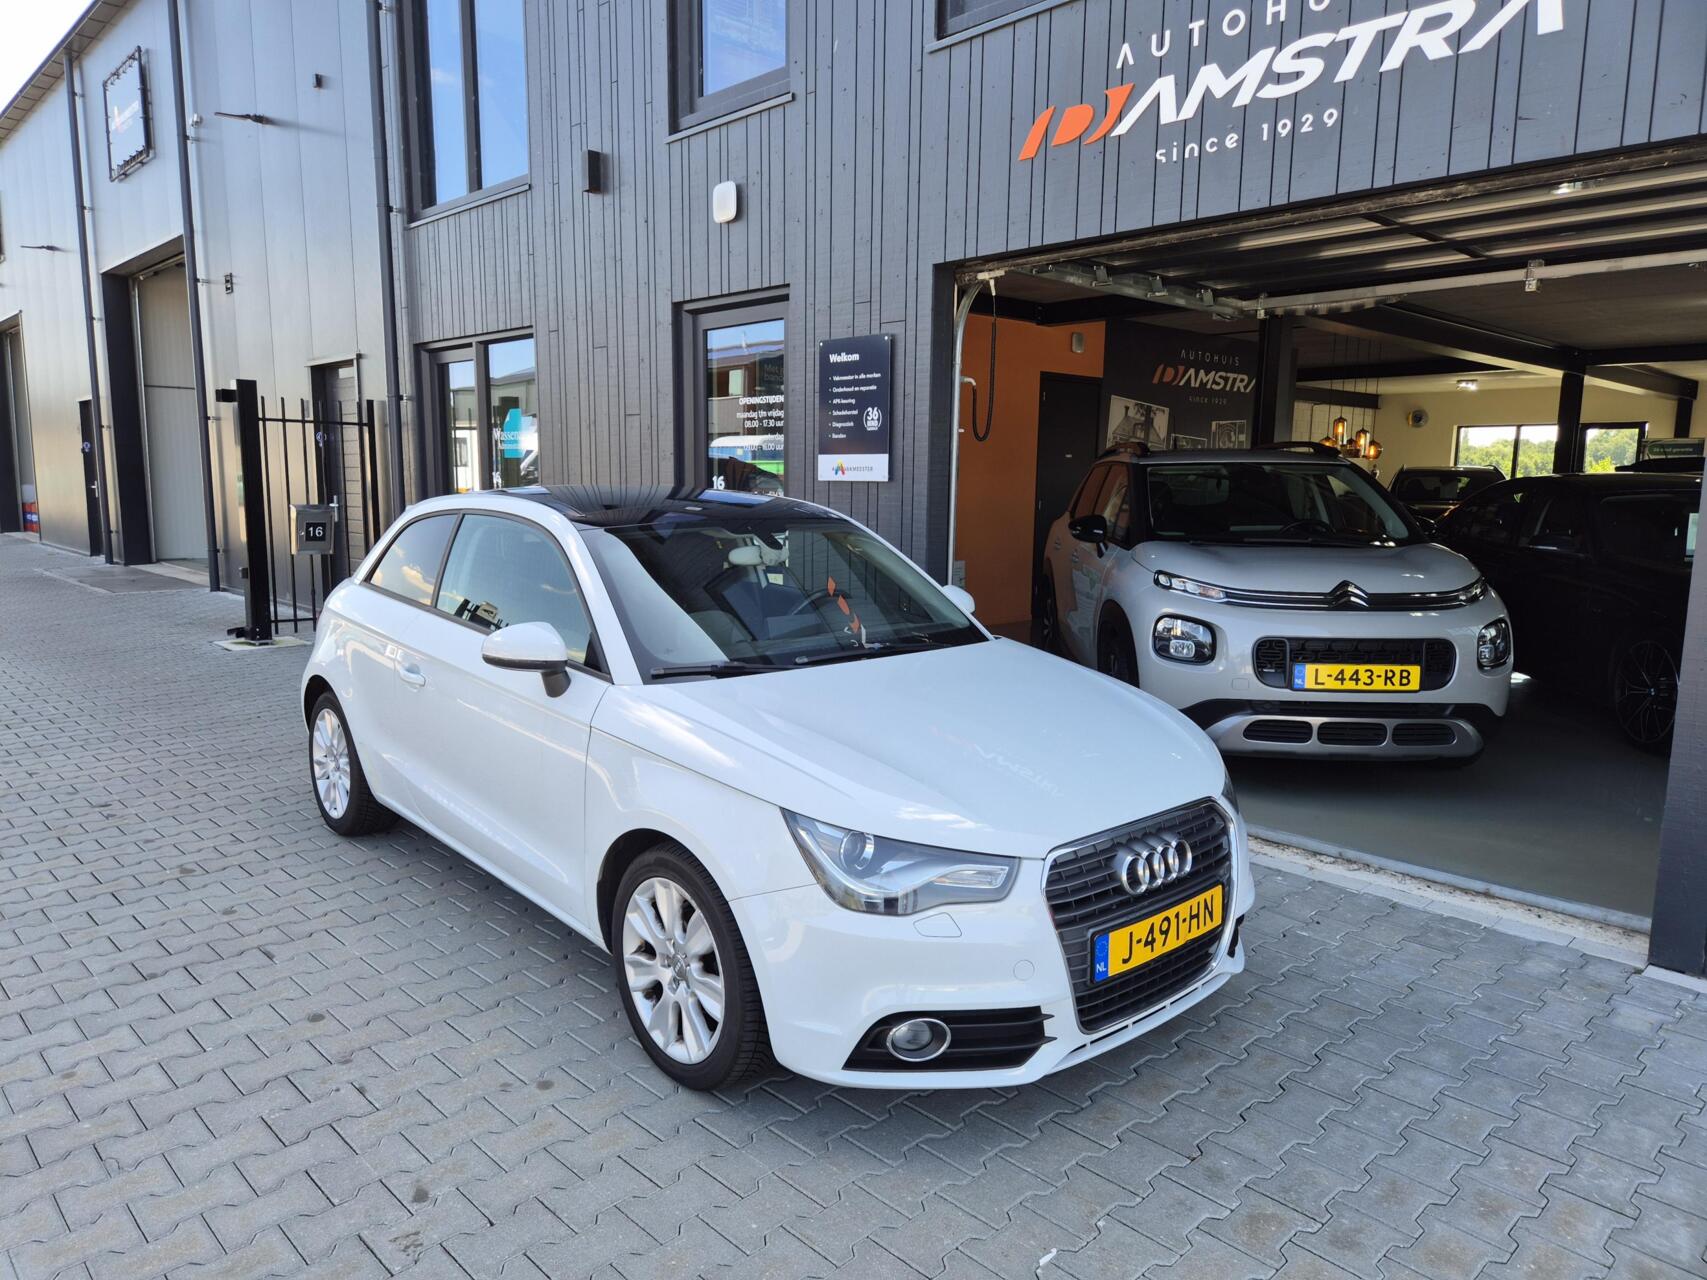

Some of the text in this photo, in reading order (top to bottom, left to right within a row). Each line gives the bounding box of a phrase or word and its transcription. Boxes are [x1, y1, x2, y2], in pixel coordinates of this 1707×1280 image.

[1154, 108, 1339, 164] since 1929
[829, 352, 860, 363] Welkom
[1180, 349, 1240, 367] AUTOHUIS
[738, 395, 784, 405] OPENINGSTIJDEN
[736, 411, 758, 419] maandag
[767, 409, 784, 418] vrijdag
[866, 407, 879, 421] 36
[712, 475, 725, 490] 16
[308, 526, 323, 537] 16
[1314, 668, 1412, 687] L-443-RB
[1121, 894, 1215, 965] J-491-HN
[1096, 961, 1107, 973] NL
